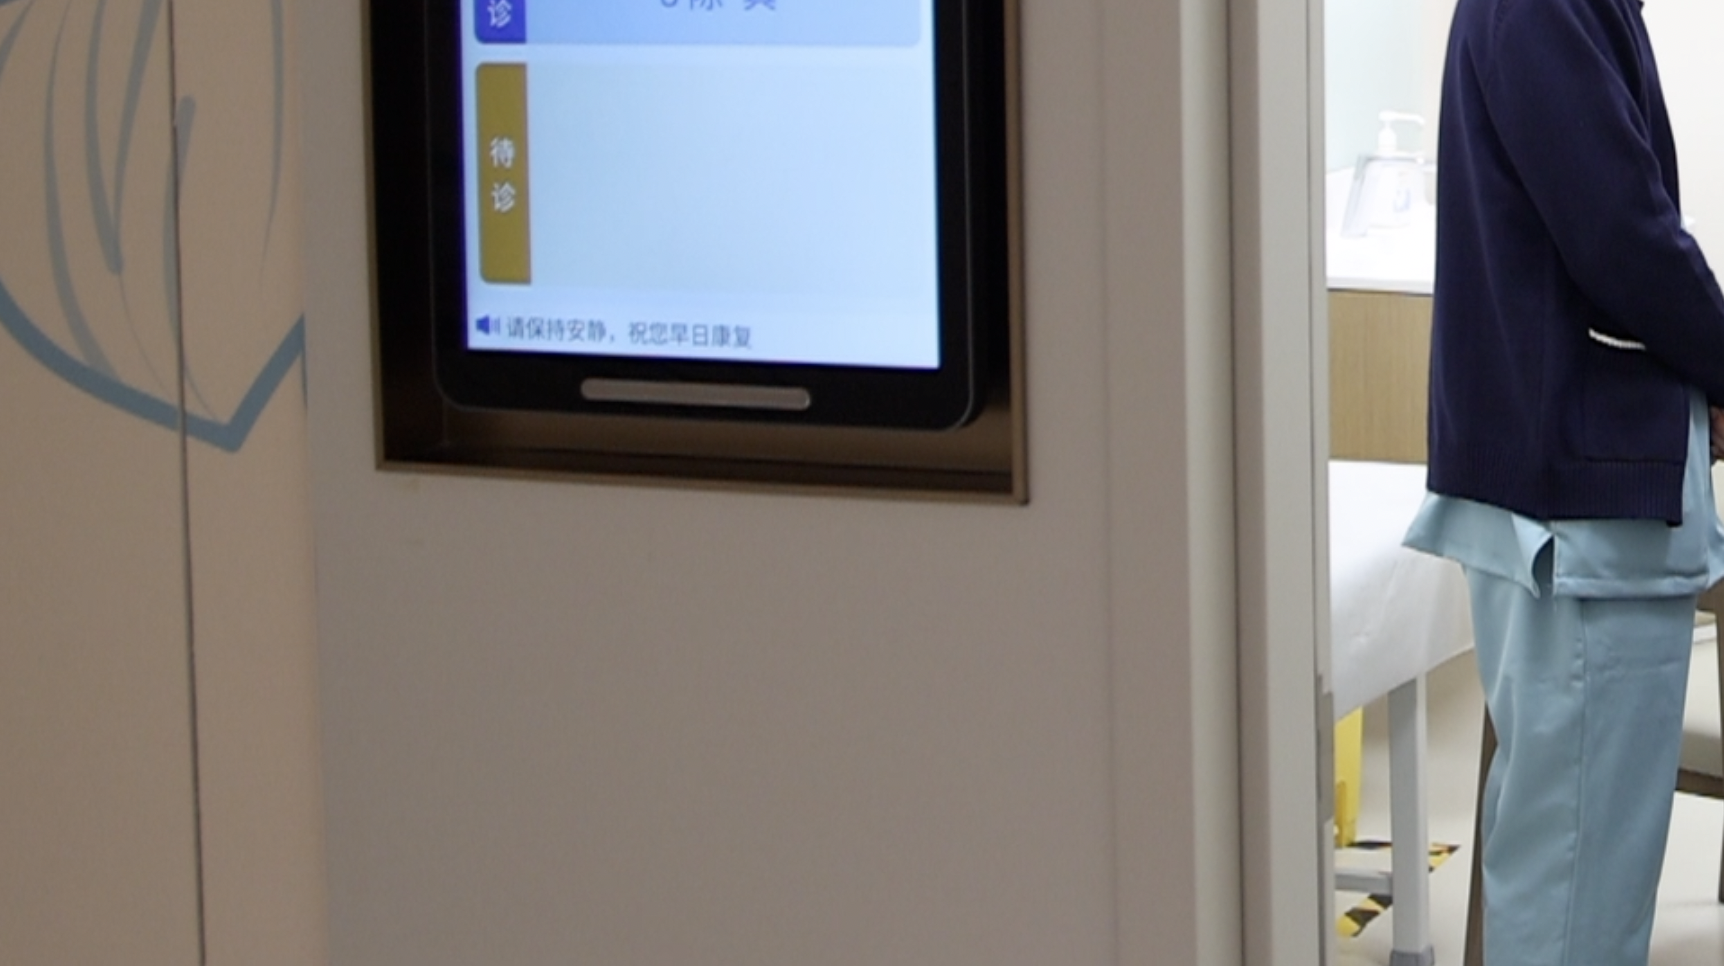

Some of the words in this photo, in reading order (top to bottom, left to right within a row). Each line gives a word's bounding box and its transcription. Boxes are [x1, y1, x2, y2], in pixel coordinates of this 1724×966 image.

[490, 137, 516, 213] 待诊
[507, 316, 752, 350] 请保持安静，祝您早日康复
